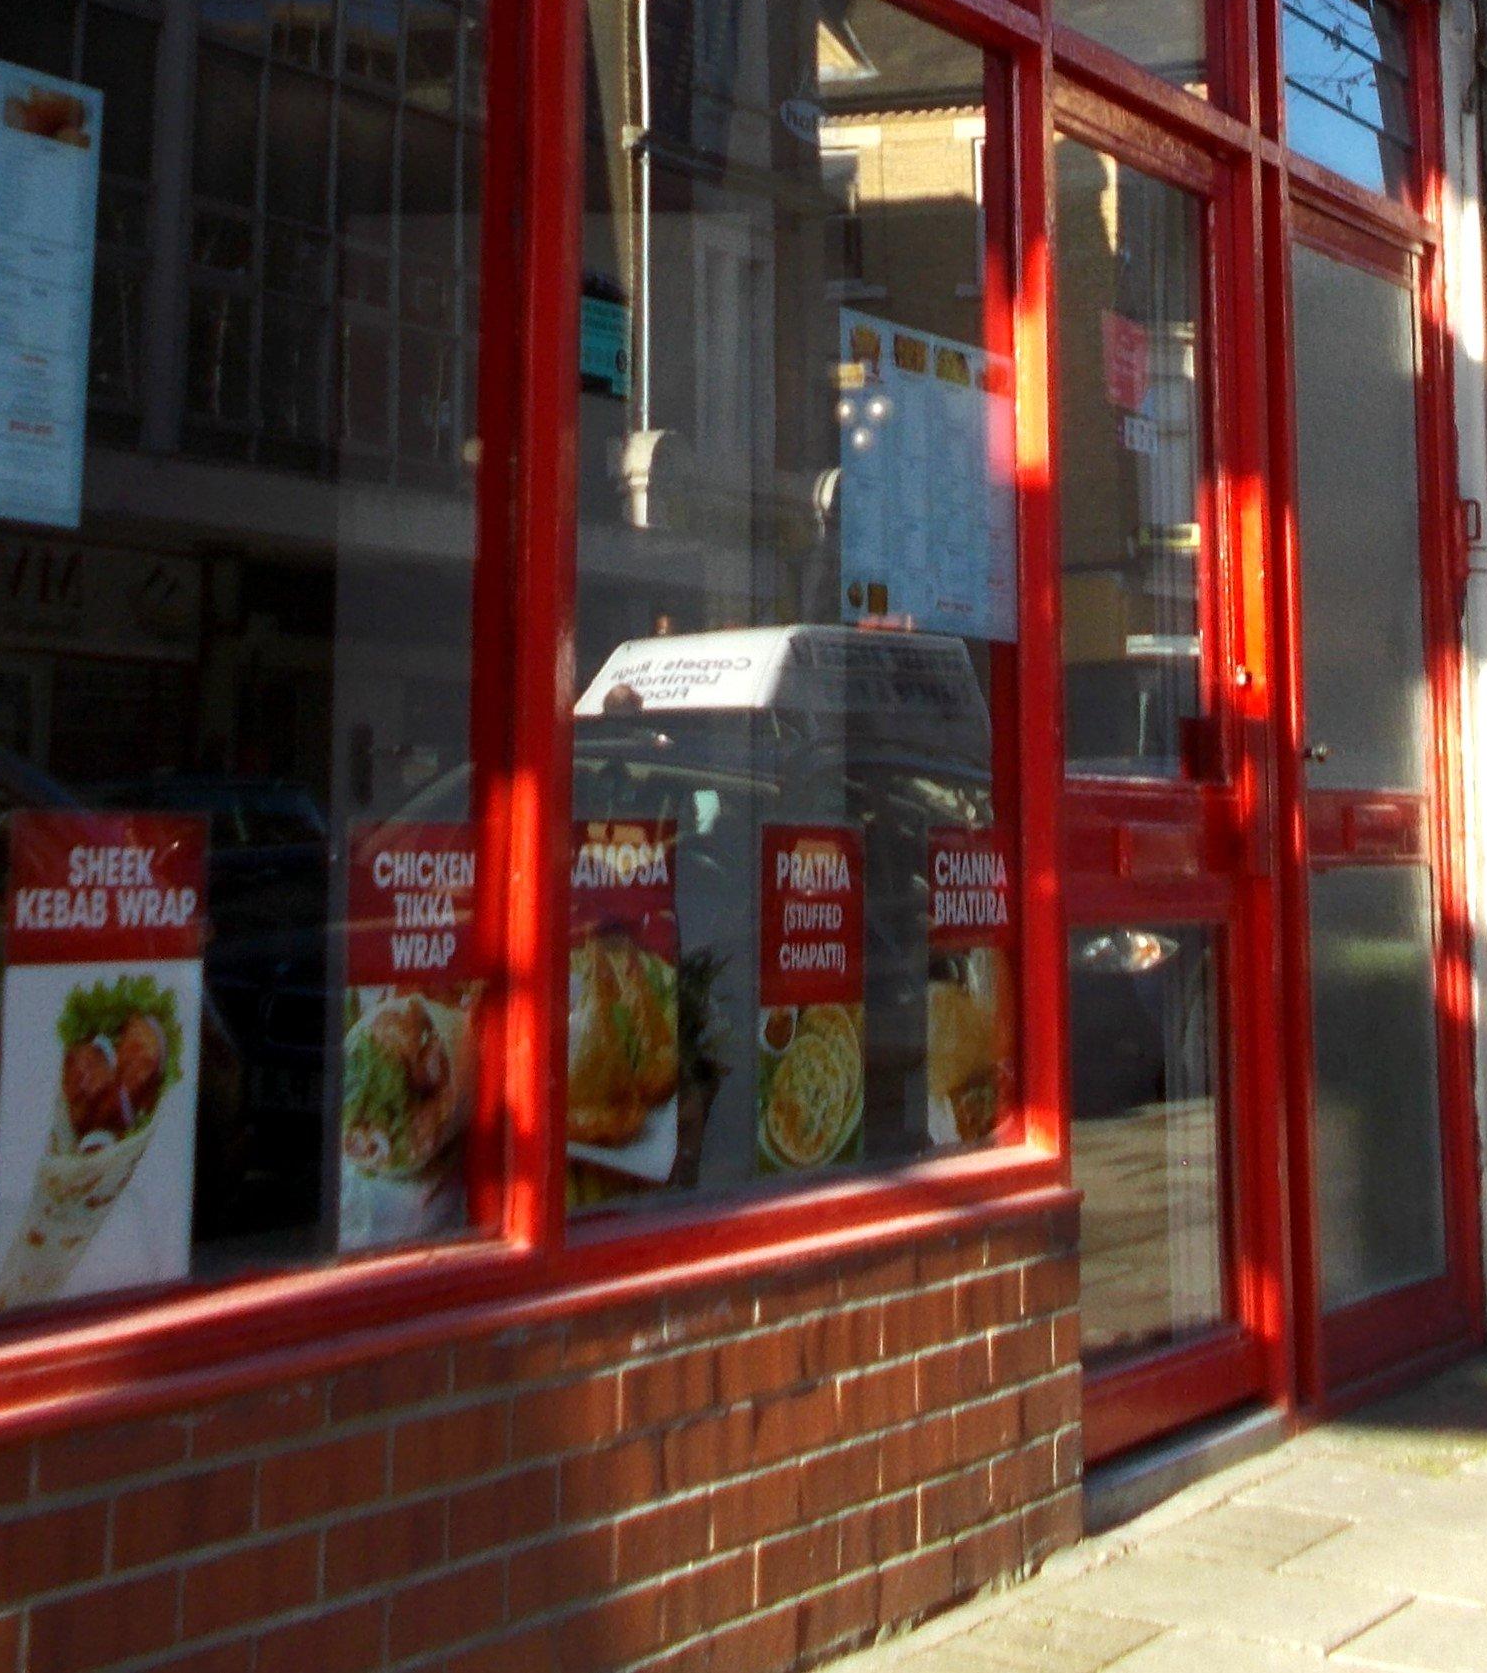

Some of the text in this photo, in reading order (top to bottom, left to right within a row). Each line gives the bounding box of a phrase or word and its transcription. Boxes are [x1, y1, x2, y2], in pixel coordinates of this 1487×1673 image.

[67, 845, 155, 888] SHEEK
[372, 849, 476, 889] CHICKEN
[570, 842, 670, 888] AMOSA
[776, 852, 851, 893] PRATHA
[934, 849, 1009, 889] CHANNA
[15, 889, 199, 930] KEBAB WRAP
[394, 892, 456, 929] TIKKA
[782, 901, 843, 933] (STUFFED
[933, 890, 1008, 928] BHATURA
[391, 934, 456, 970] WRAP
[779, 942, 847, 974] CHAPATTI)
